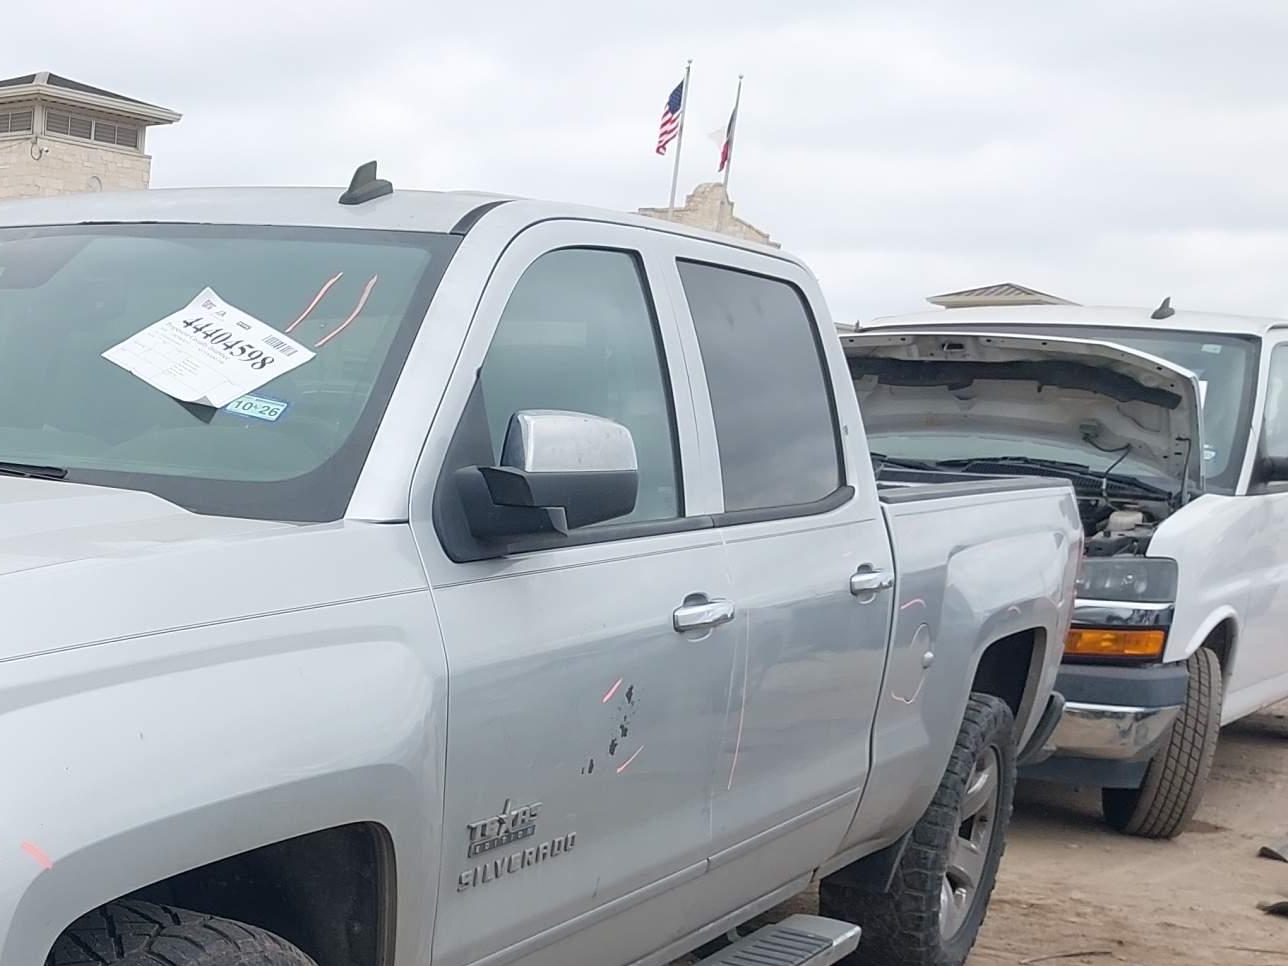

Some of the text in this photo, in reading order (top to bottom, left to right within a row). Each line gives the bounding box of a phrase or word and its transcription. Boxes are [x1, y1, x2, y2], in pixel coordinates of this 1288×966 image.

[183, 317, 274, 369] 44404598
[234, 399, 253, 412] 10
[259, 405, 281, 417] 26
[467, 799, 543, 841] TEXAS
[457, 831, 576, 892] SILVERADO
